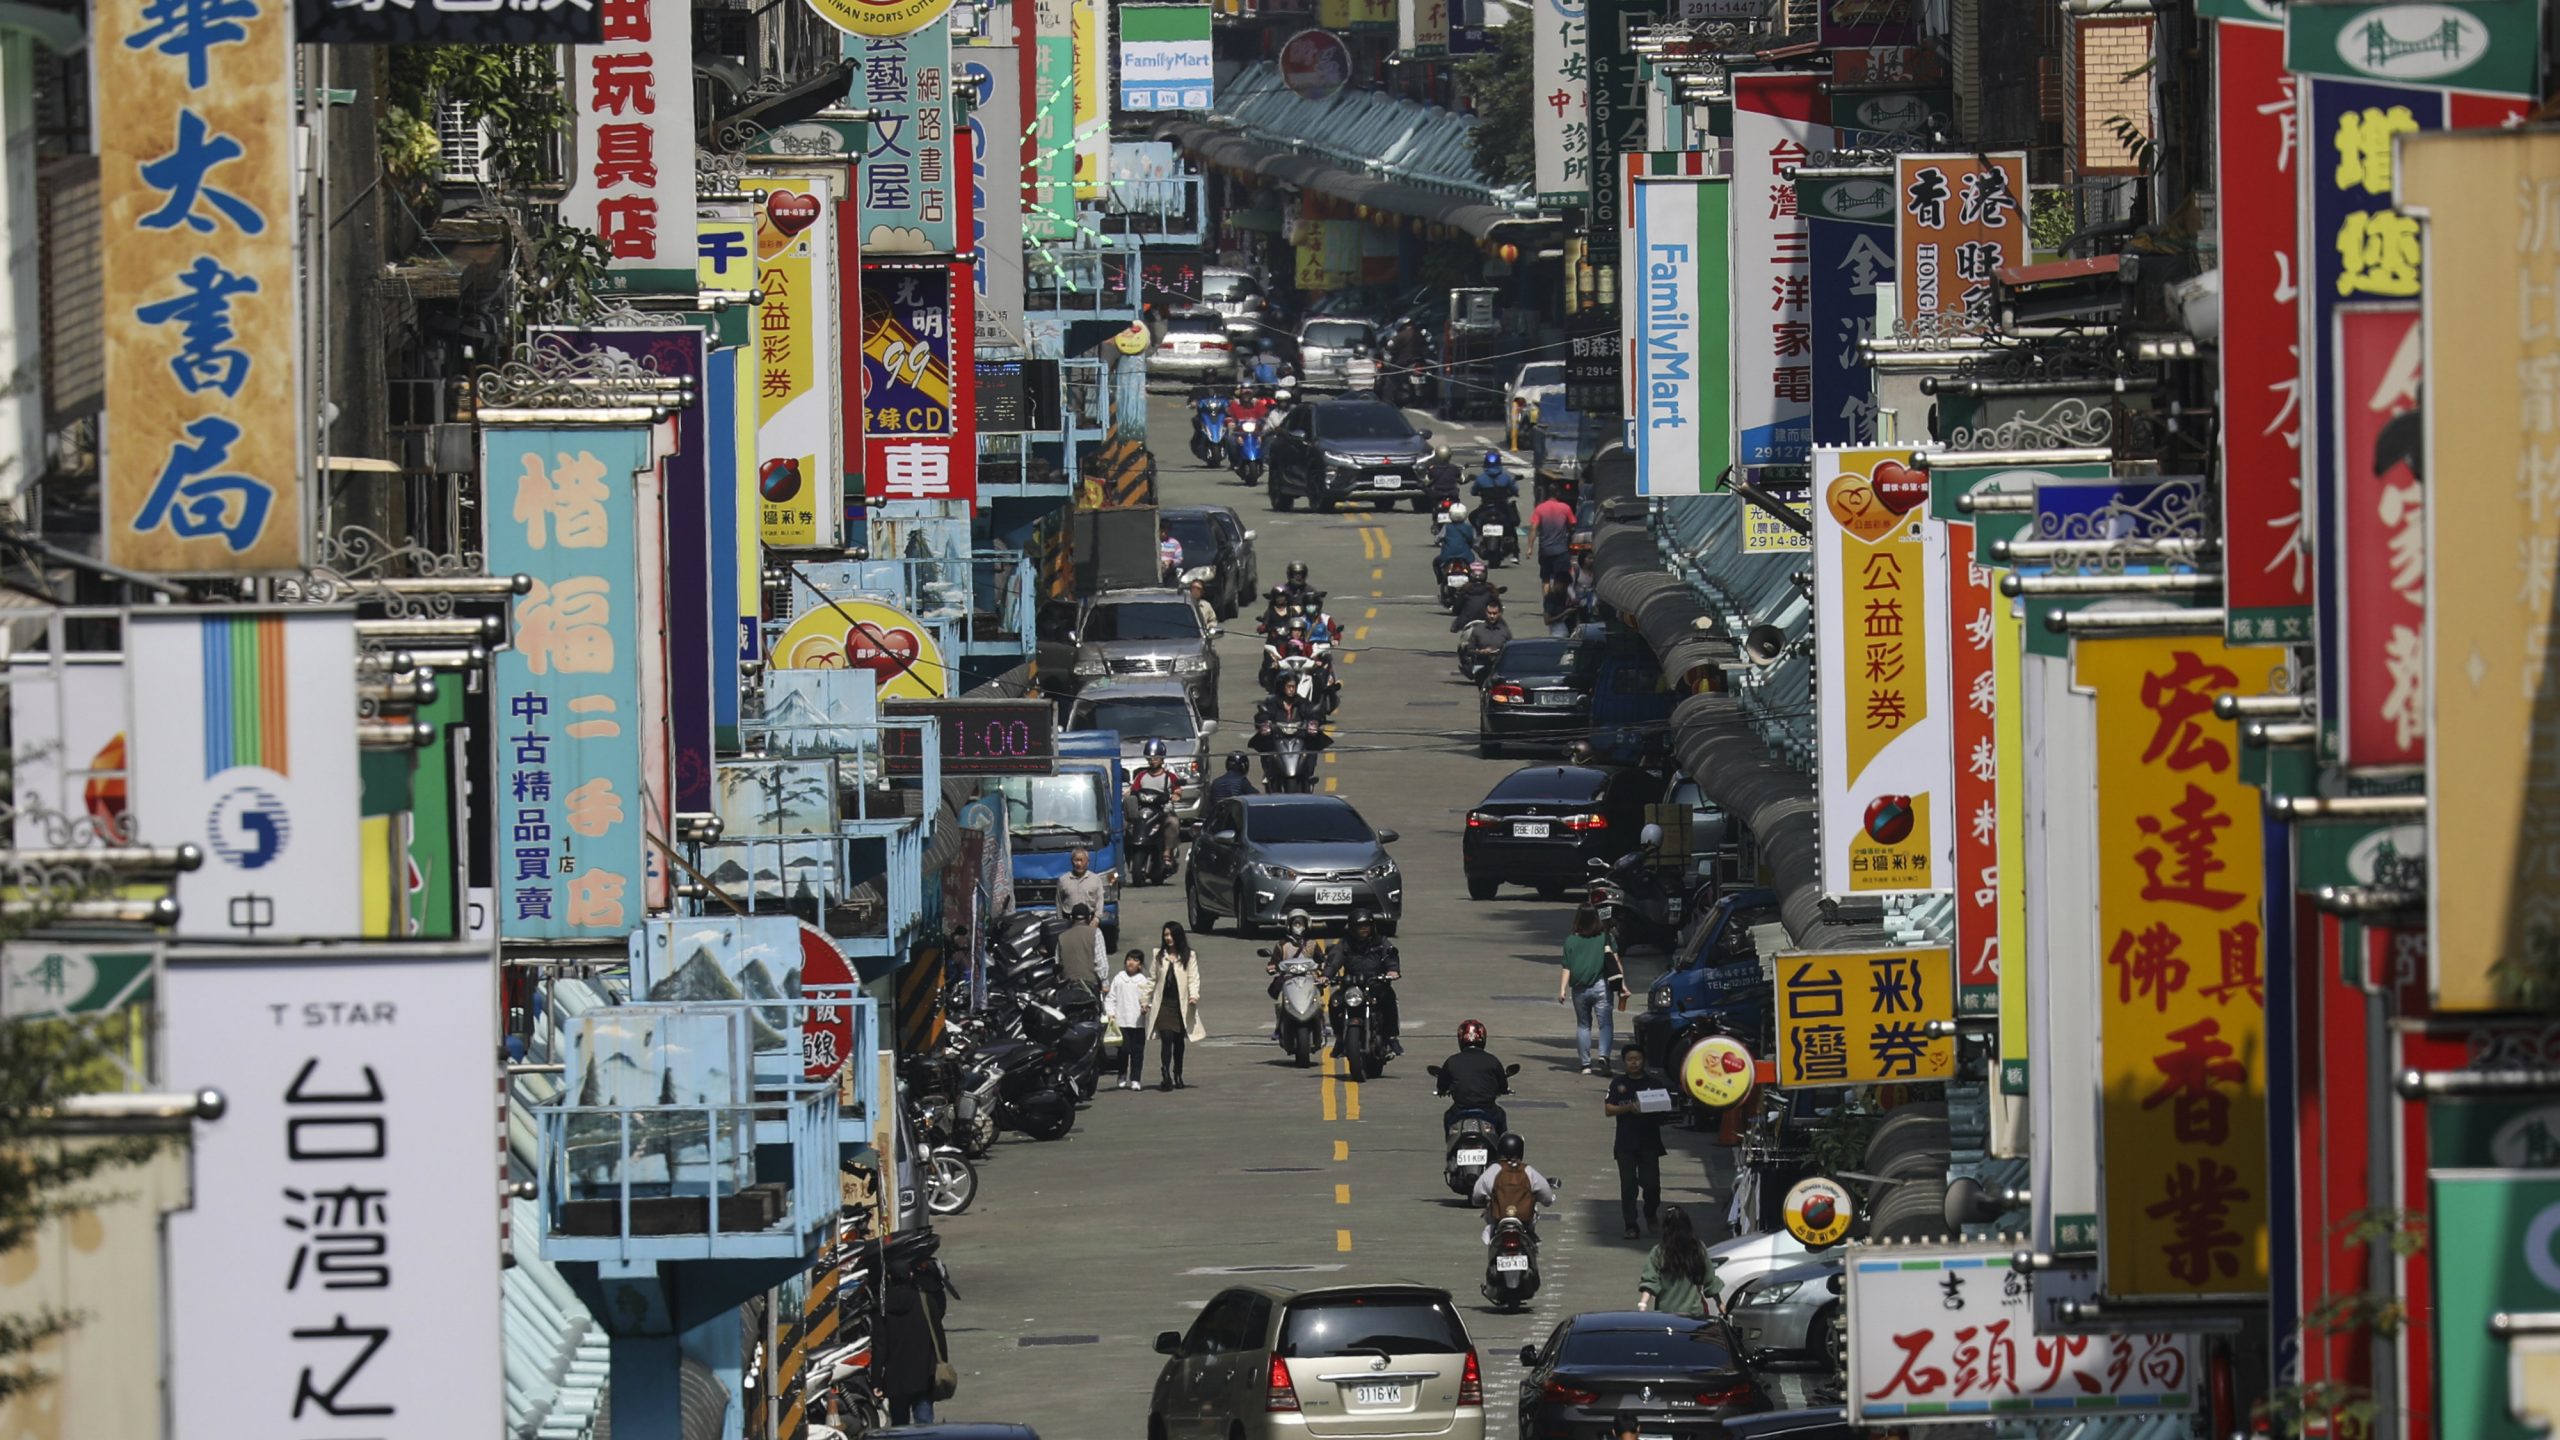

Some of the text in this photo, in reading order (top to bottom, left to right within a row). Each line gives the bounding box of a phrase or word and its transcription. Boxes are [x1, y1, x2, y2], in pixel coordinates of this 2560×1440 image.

[863, 12, 904, 23] SPORTS
[1124, 51, 1210, 71] FamilyMart
[916, 67, 945, 223] 網路書店
[1768, 138, 1811, 404] 台灣三洋家電
[760, 267, 792, 399] 公益彩券
[881, 340, 932, 390] 99
[1648, 243, 1691, 430] FamilyMart
[884, 442, 950, 497] 車
[1863, 552, 1906, 729] 公益彩券
[513, 449, 627, 928] 惜福二手店
[955, 720, 1028, 757] 1:00
[509, 691, 553, 921] 中古精品買賣
[1852, 853, 1927, 871] 台灣彩券
[268, 1002, 398, 1027] T STAR
[1865, 1319, 2186, 1402] 石頭火鍋
